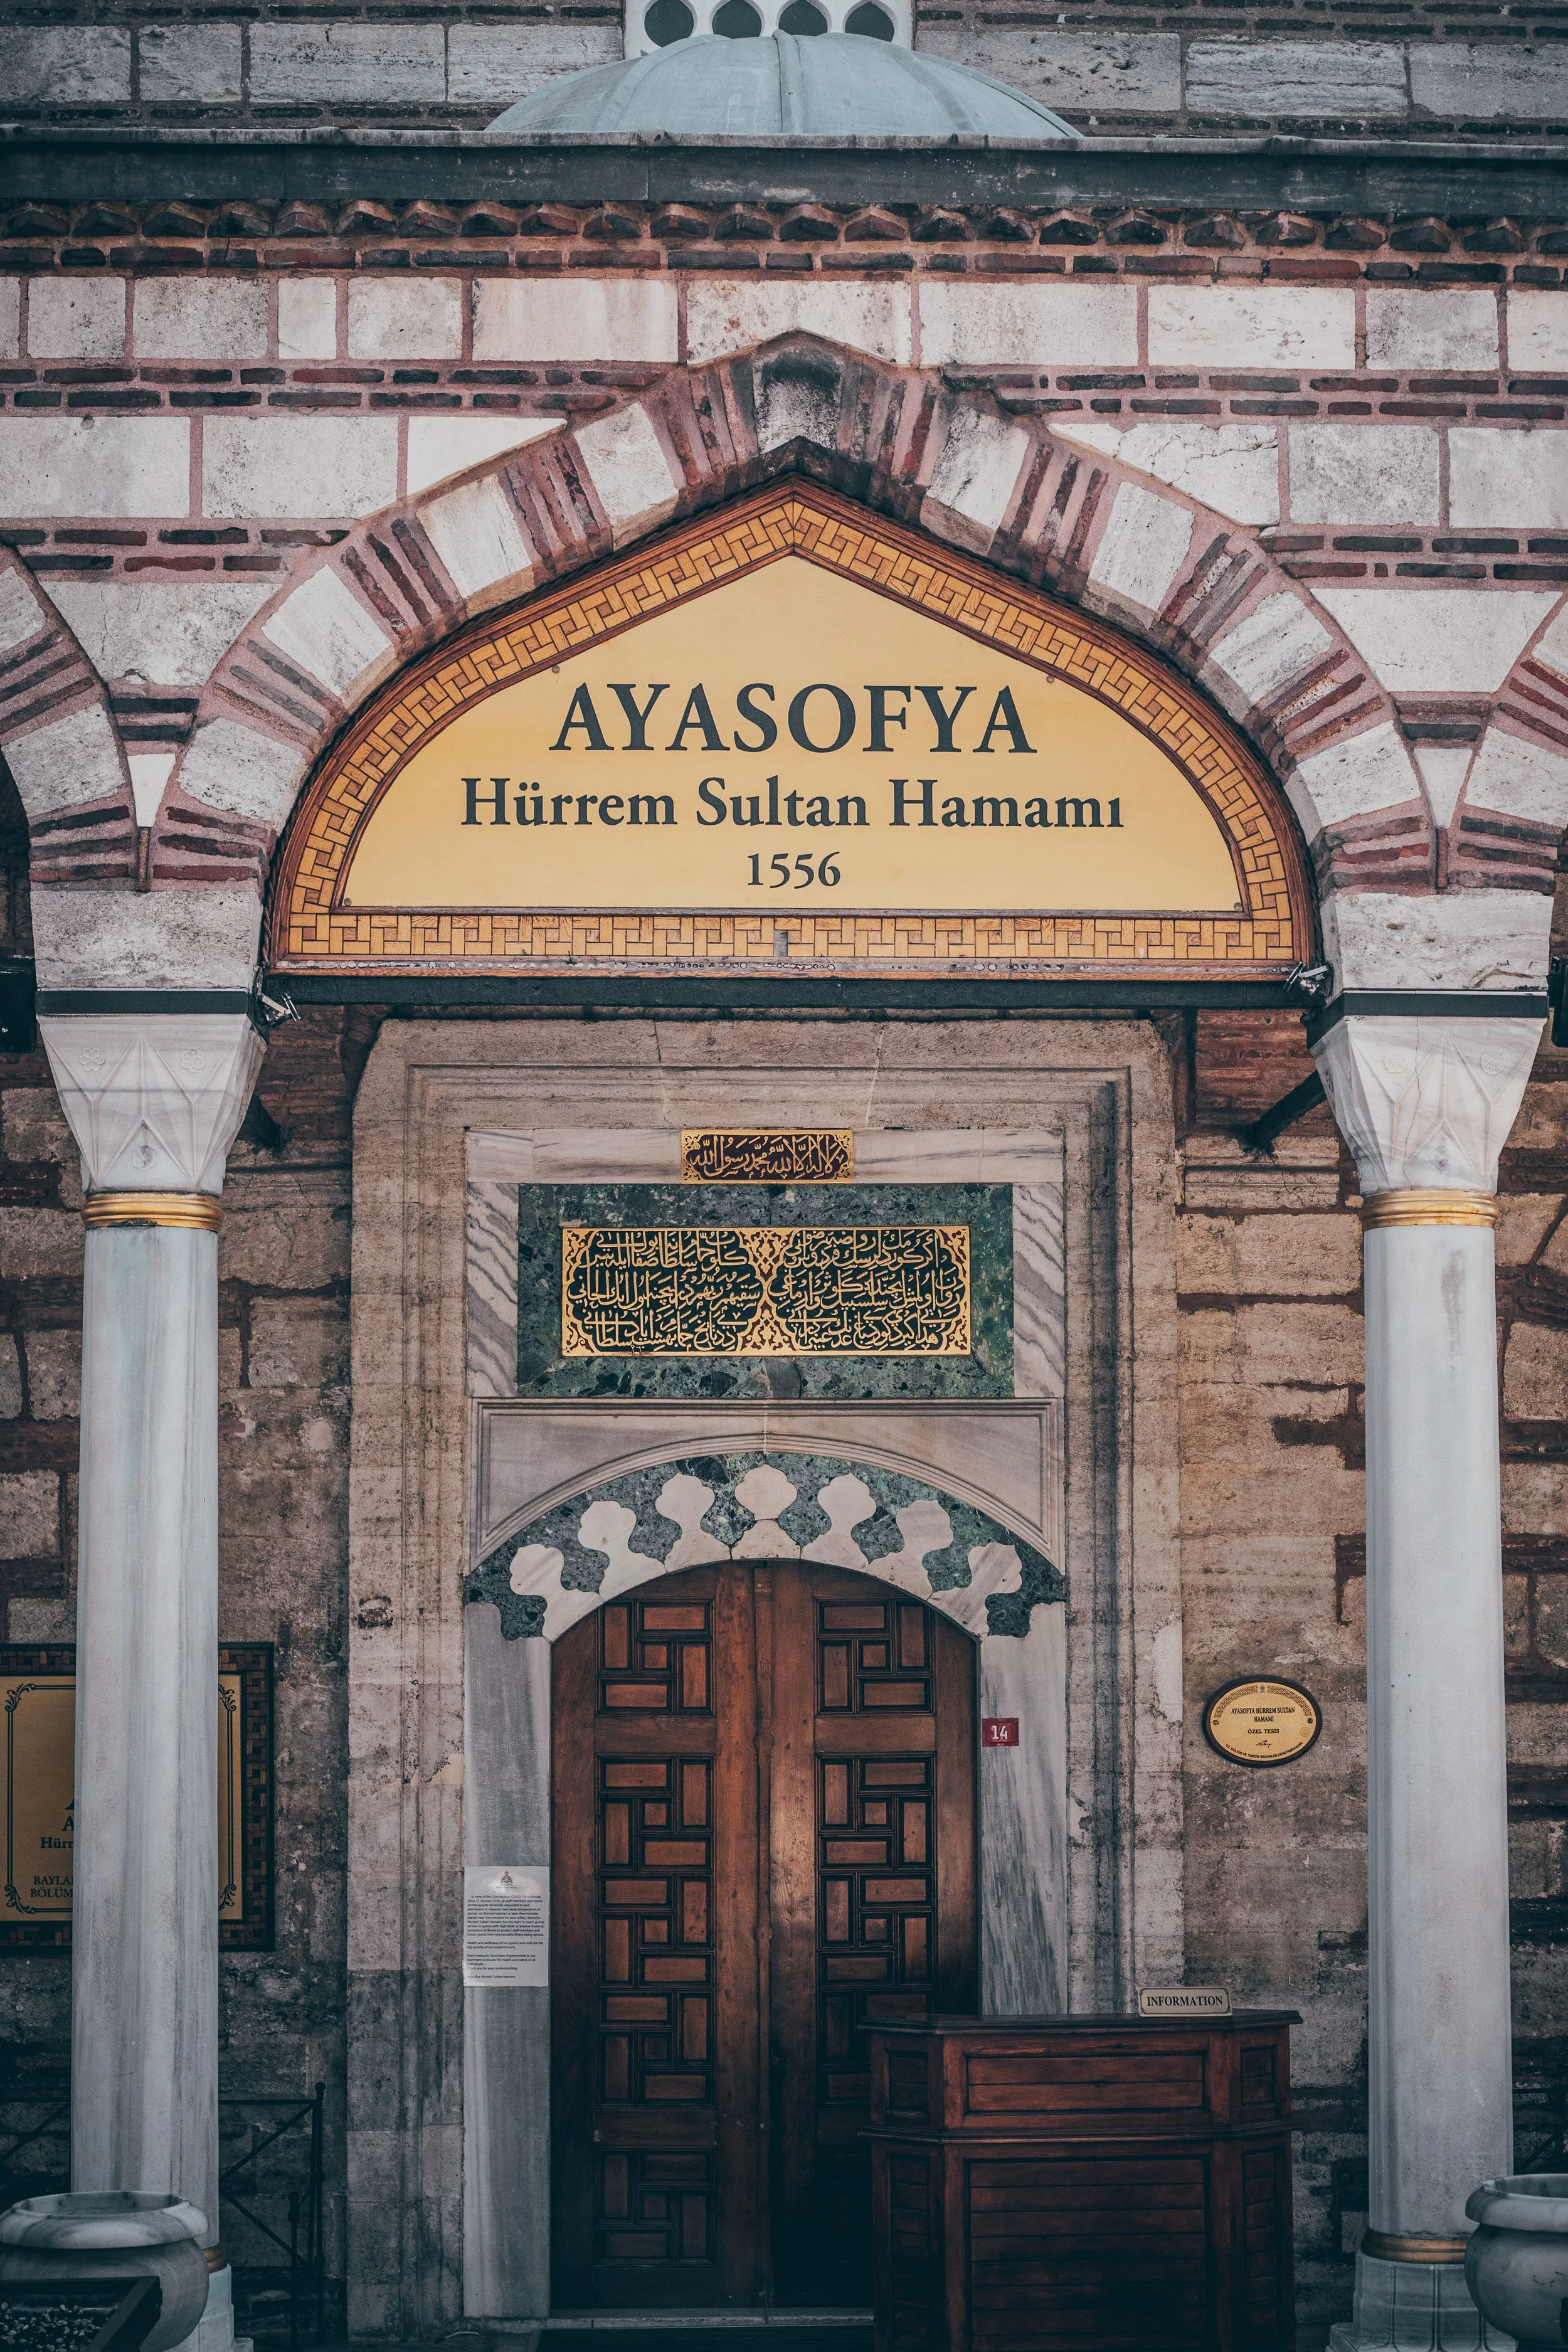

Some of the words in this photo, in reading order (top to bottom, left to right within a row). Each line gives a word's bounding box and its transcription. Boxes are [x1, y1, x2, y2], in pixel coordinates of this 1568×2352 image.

[549, 682, 1037, 753] AYASOFYA
[461, 777, 677, 826] Hürrem
[697, 775, 870, 826] Sultan
[889, 778, 1124, 828] Hamamı
[748, 851, 840, 889] 1556
[991, 1725, 1008, 1740] 14
[1147, 1996, 1223, 2006] INFORMATION
